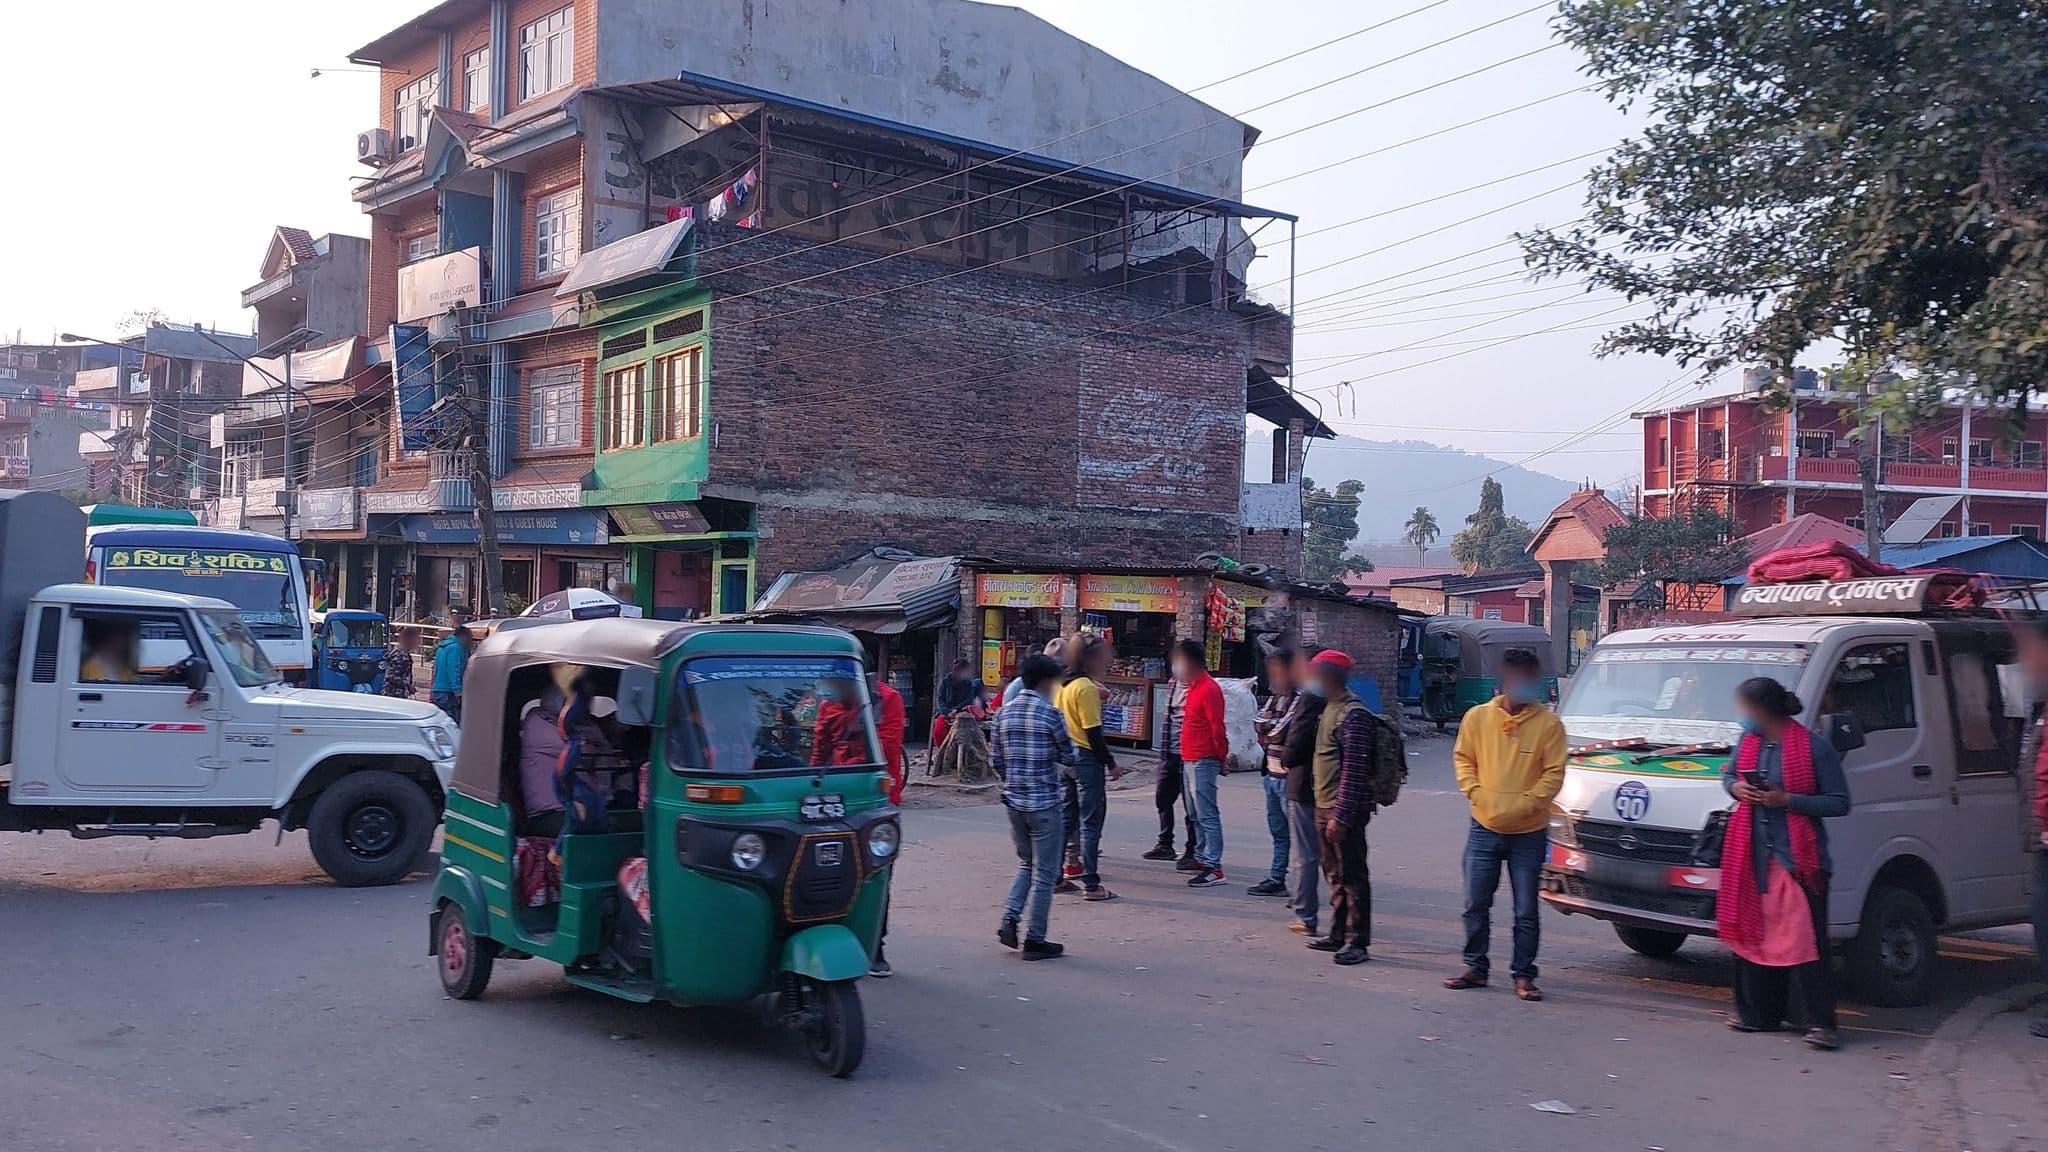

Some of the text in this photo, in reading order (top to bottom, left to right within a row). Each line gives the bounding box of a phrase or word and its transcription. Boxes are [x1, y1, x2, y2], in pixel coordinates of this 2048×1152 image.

[536, 517, 558, 529] HOUSE
[133, 549, 270, 569] शिव शक्ति
[225, 734, 270, 744] BOLERO
